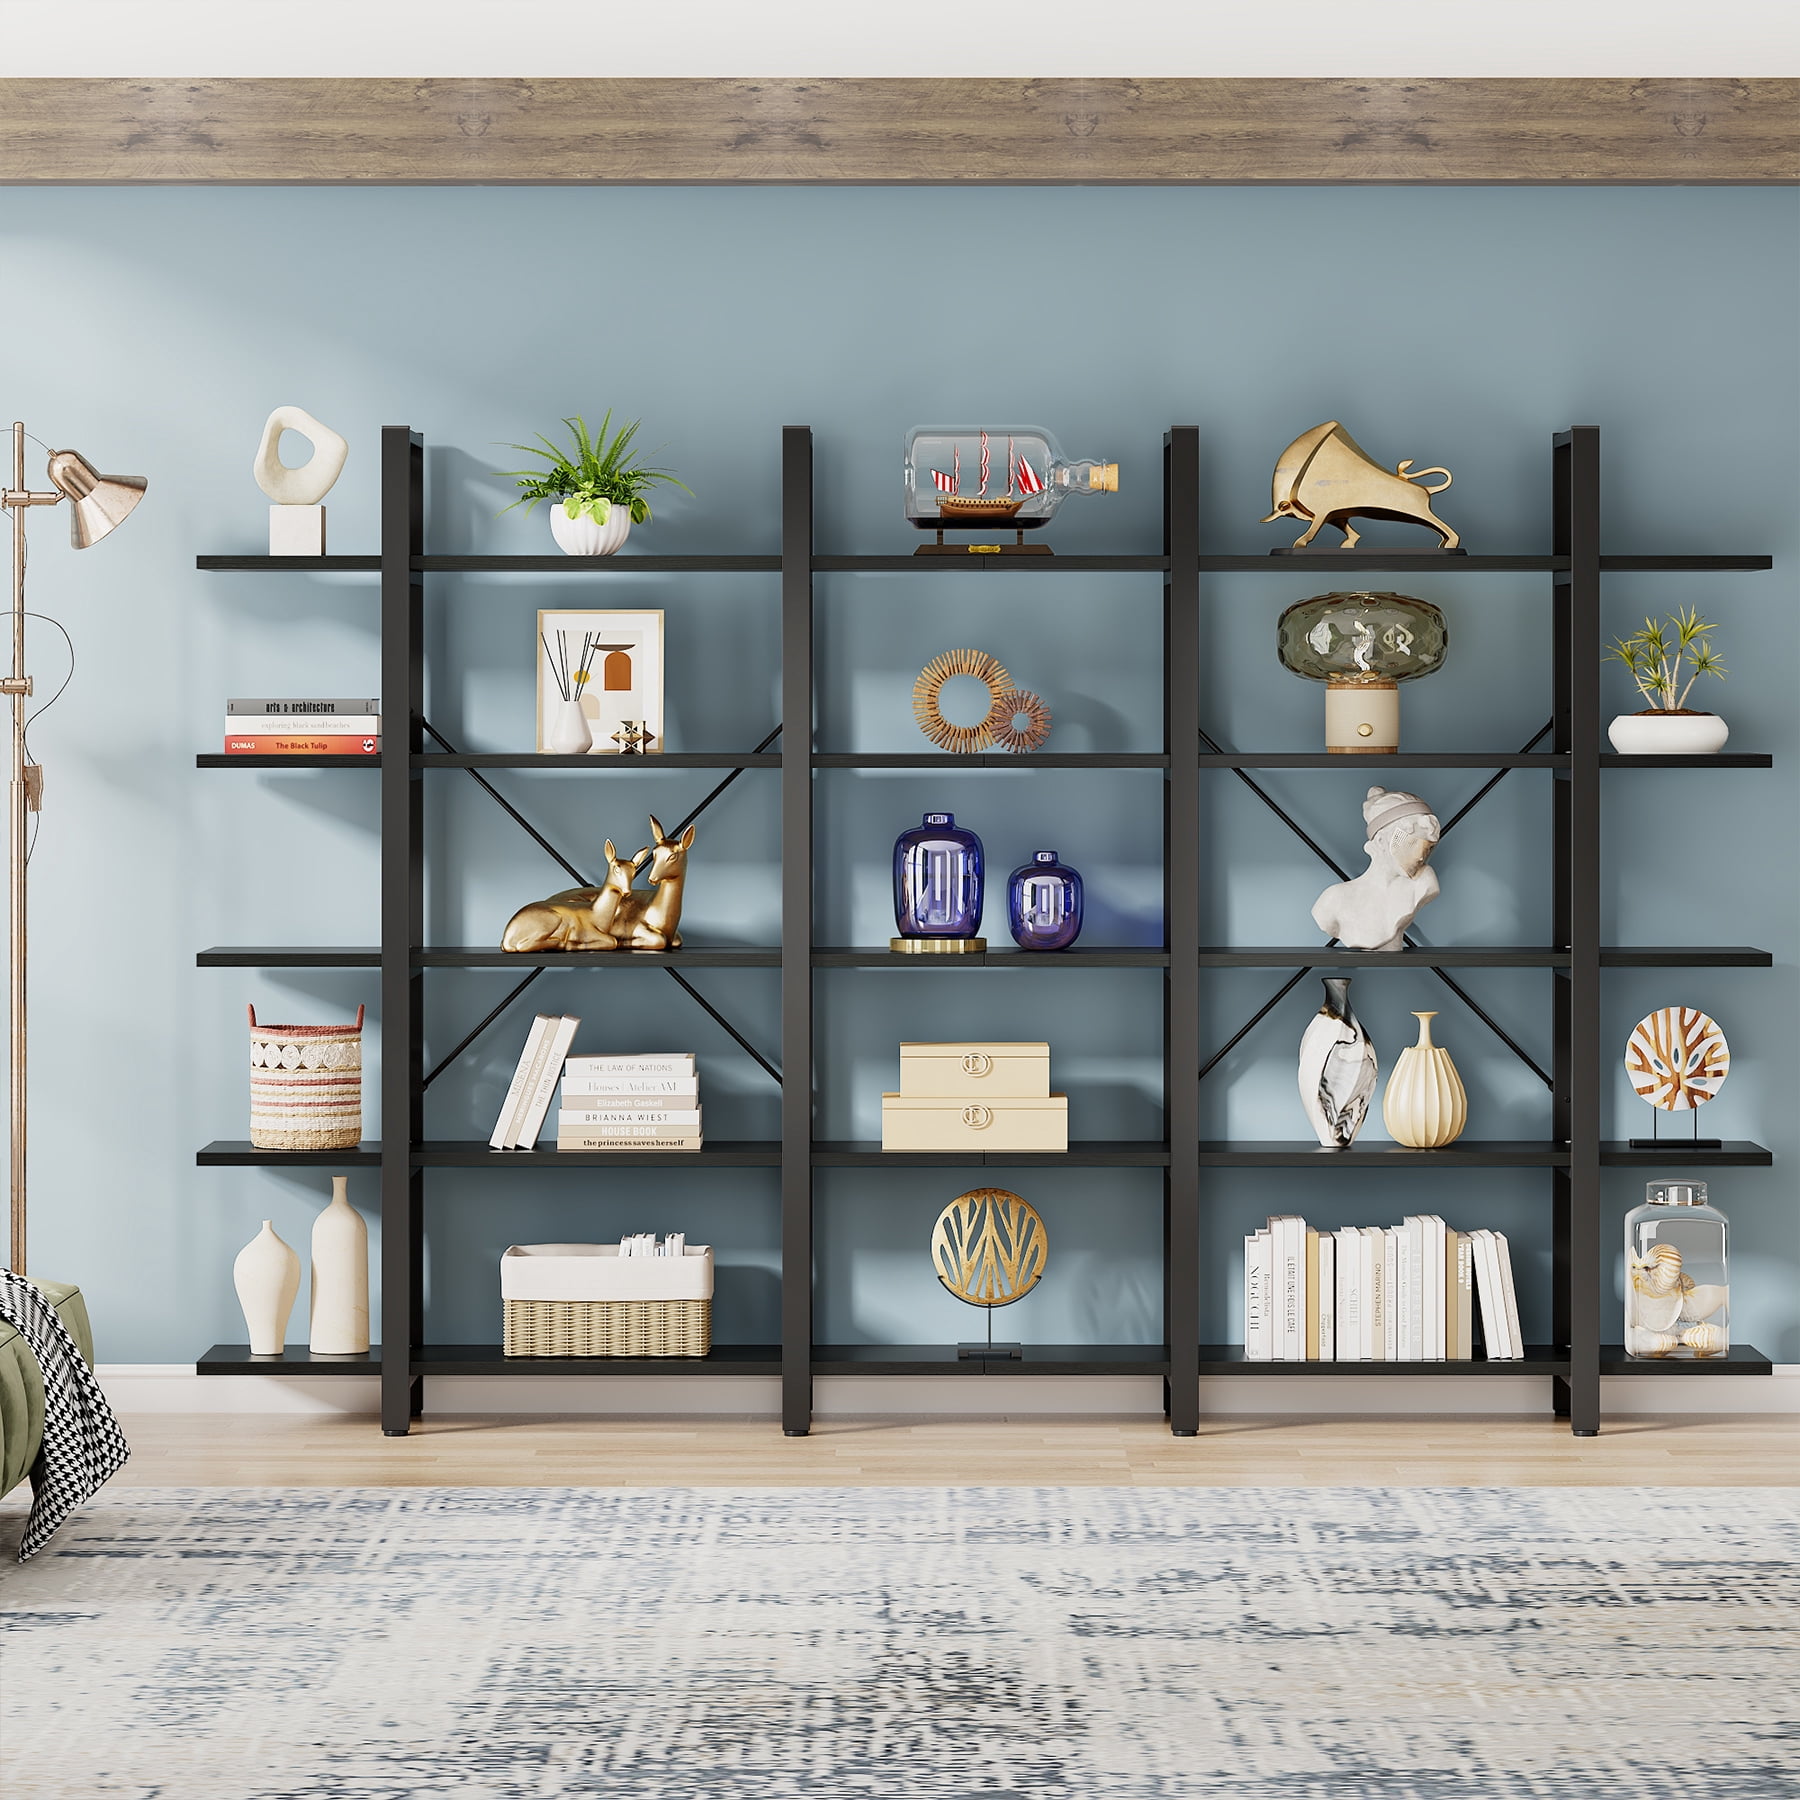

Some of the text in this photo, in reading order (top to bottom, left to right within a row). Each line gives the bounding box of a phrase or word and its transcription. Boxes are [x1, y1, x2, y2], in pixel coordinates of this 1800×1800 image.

[266, 702, 280, 713] arts
[291, 702, 335, 713] architecture
[310, 742, 328, 750] Tulip
[589, 1064, 673, 1072] THE LAW OF NATIONS
[511, 1059, 531, 1097] MISENA
[535, 1095, 545, 1108] THE
[546, 1052, 561, 1078] JUSTICE
[597, 1099, 663, 1107] Elizabeth Gaskell
[601, 1127, 657, 1136] HOUSE BOOK
